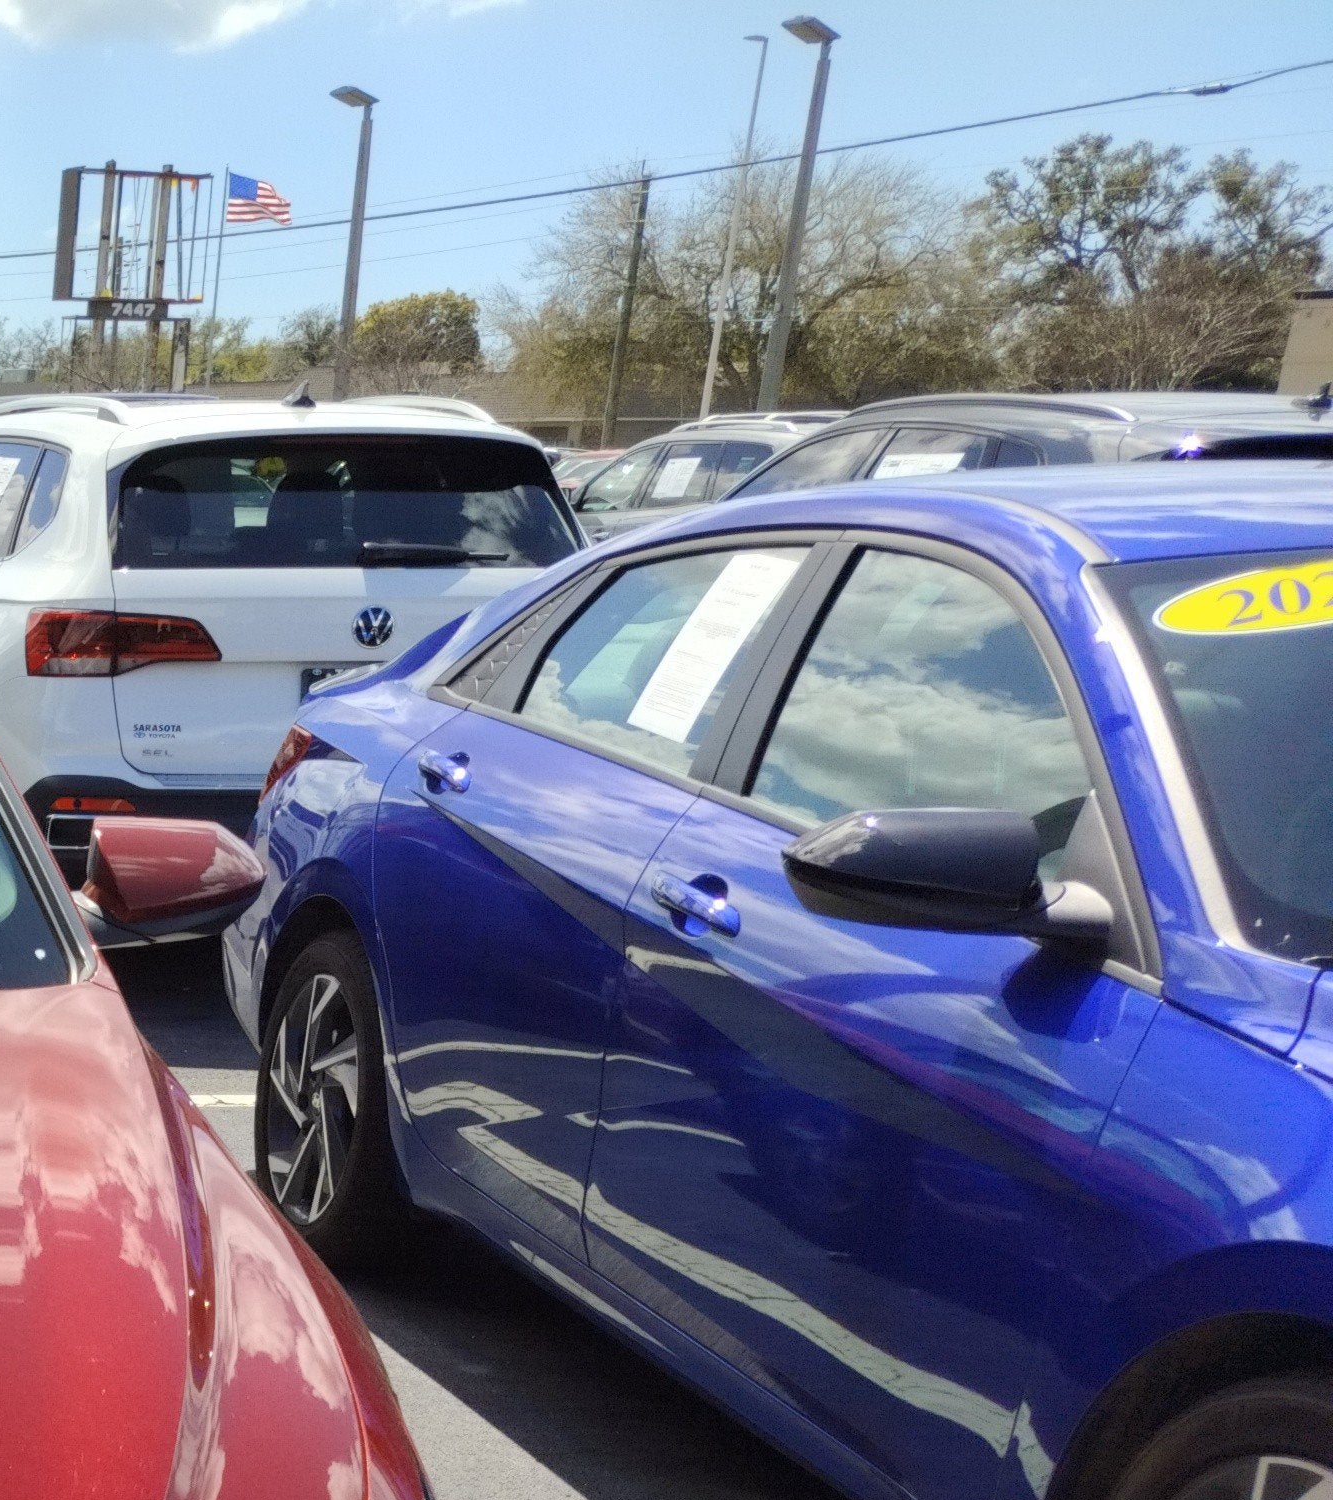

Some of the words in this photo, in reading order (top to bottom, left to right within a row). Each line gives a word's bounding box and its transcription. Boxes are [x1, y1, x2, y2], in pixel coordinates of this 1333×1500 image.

[111, 302, 156, 317] 7447
[133, 724, 182, 732] SARASOTA
[142, 749, 173, 757] SEL
